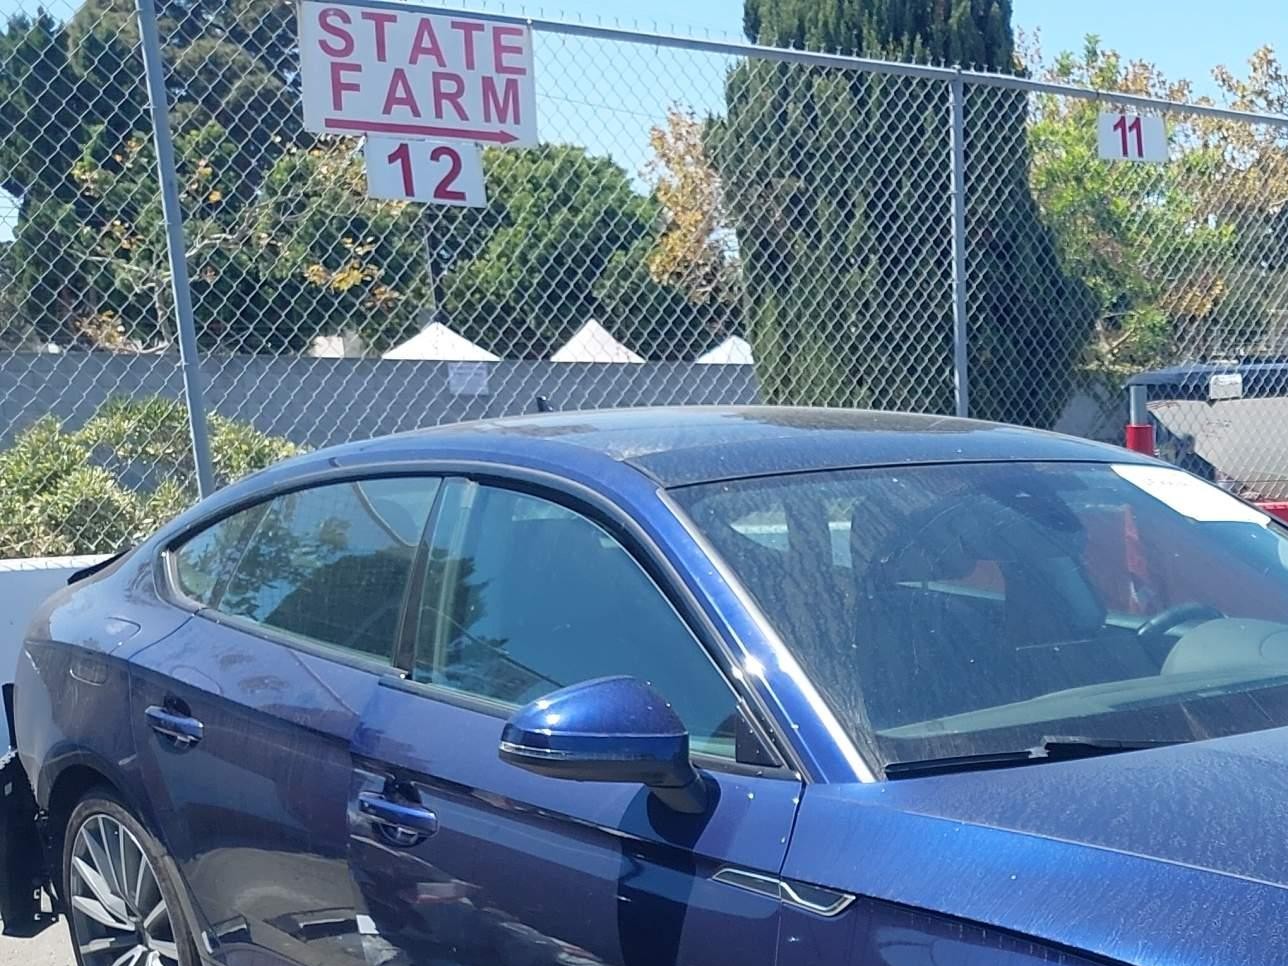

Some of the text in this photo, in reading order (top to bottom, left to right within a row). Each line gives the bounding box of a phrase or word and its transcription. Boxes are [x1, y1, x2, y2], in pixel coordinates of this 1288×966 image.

[318, 7, 527, 76] STATE
[330, 61, 521, 125] FARM
[1113, 115, 1144, 159] 11
[387, 143, 467, 201] 12
